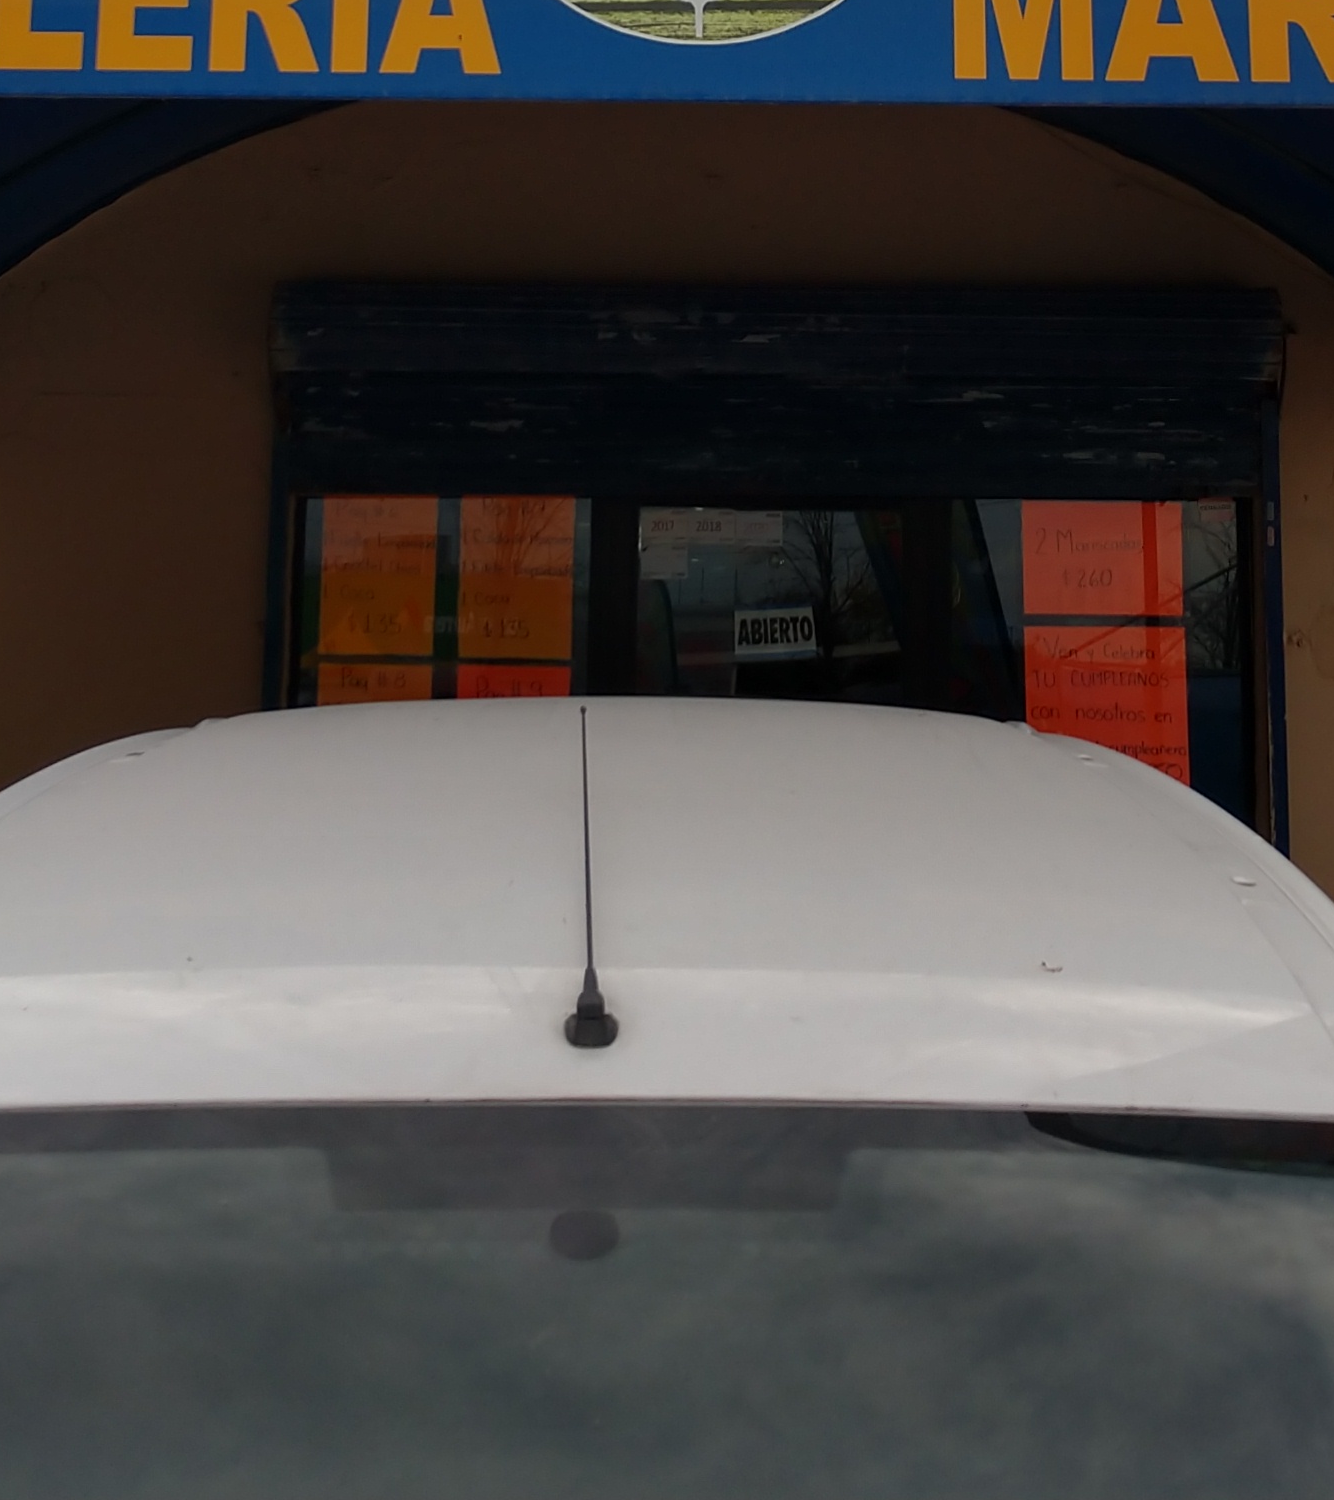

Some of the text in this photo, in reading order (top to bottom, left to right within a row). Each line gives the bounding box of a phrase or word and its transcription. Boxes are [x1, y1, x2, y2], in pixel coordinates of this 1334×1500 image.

[737, 615, 814, 646] ABIERTO
[1033, 668, 1056, 688] TU
[1031, 702, 1173, 724] con nosotros en
